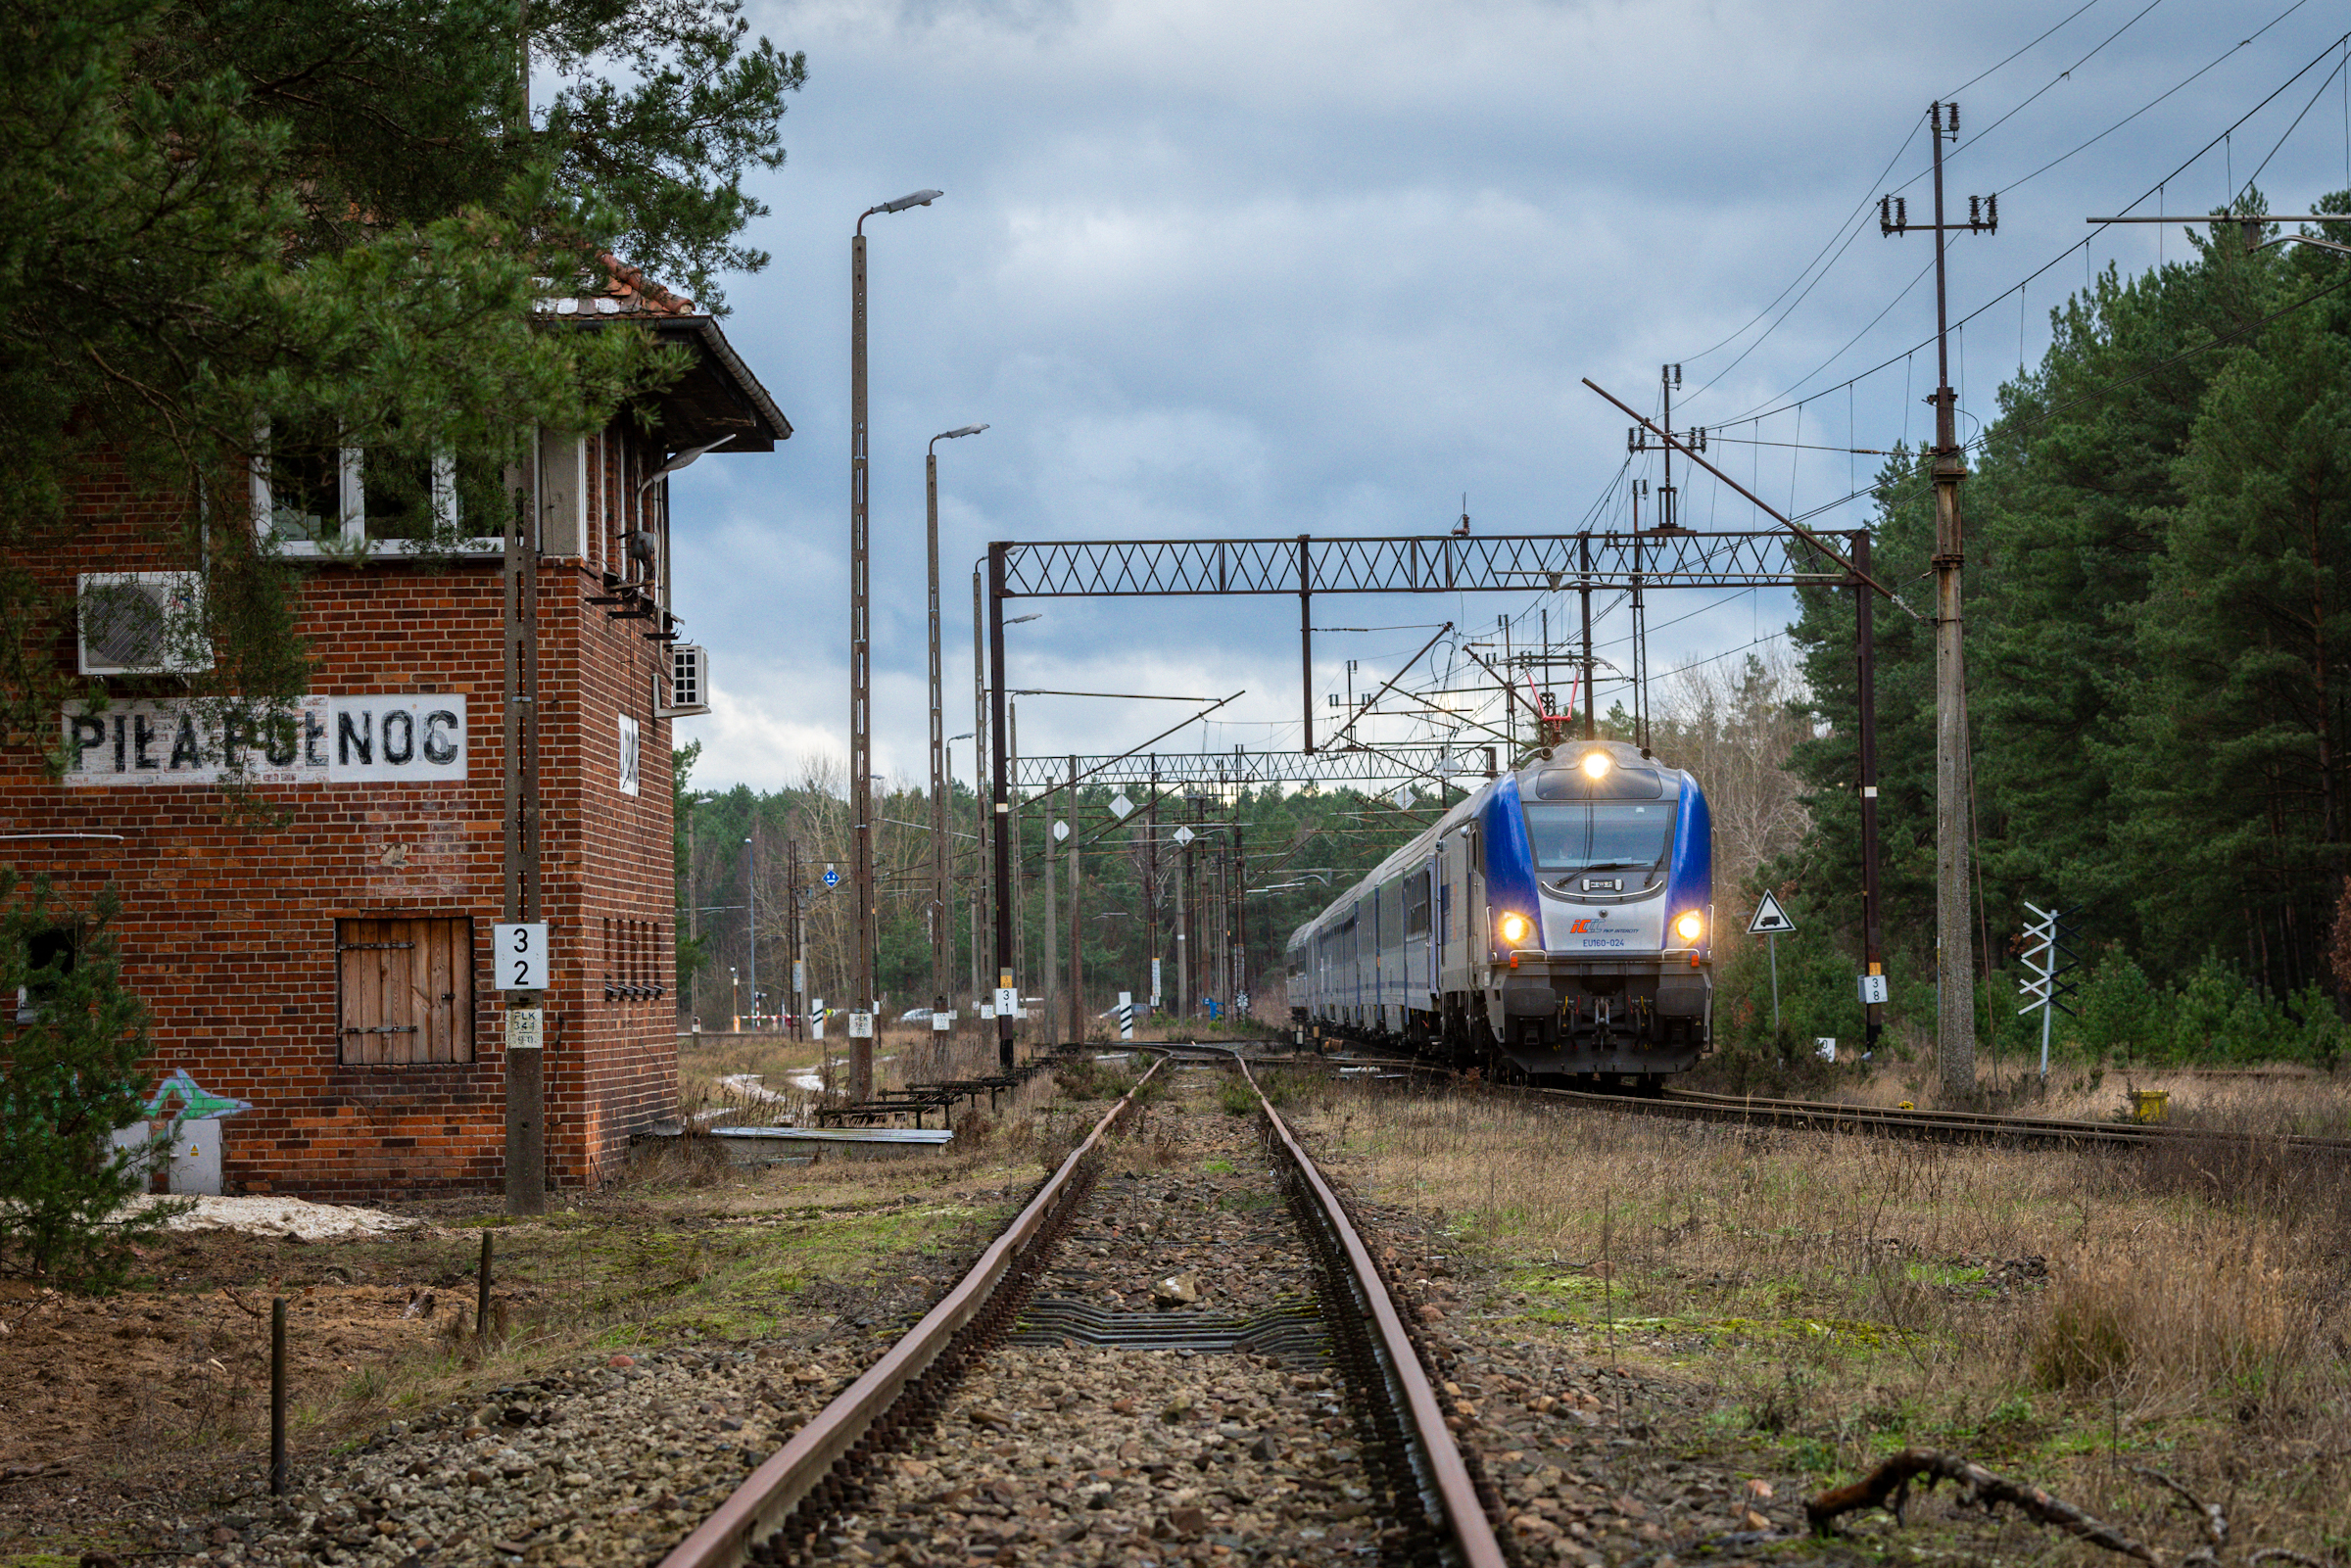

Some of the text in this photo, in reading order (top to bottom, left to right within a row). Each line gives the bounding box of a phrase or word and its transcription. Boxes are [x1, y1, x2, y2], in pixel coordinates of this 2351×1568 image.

[72, 713, 202, 772] PIŁA
[513, 928, 528, 953] 3
[1583, 938, 1624, 947] EU160-024
[514, 960, 529, 985] 2
[1873, 978, 1878, 988] 3
[1003, 989, 1010, 1000] 3
[1874, 991, 1880, 1000] 8
[1005, 1003, 1009, 1013] 1
